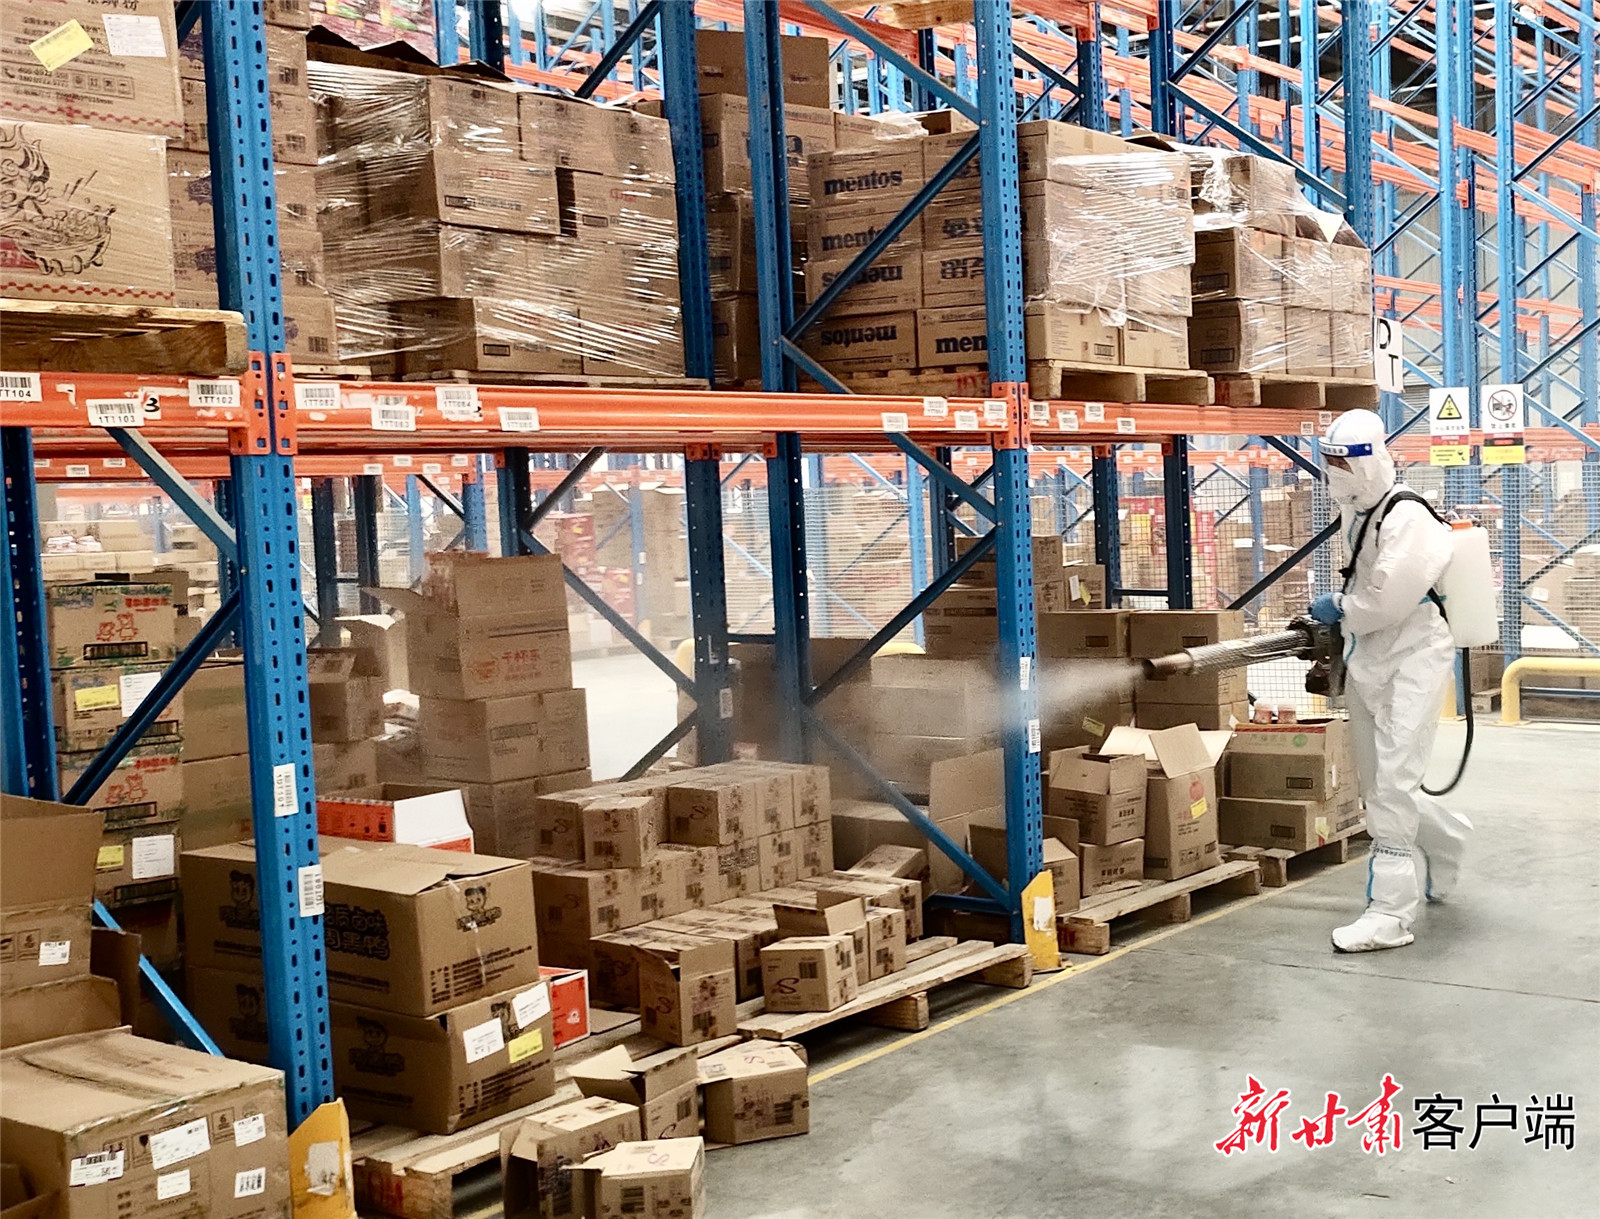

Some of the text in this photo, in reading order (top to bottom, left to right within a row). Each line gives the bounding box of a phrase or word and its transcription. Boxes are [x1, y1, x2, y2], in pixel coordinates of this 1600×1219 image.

[823, 170, 903, 196] mentos
[821, 325, 897, 347] mentos
[935, 334, 987, 354] men
[143, 397, 160, 413] 3
[198, 395, 233, 404] 1TT102
[98, 415, 136, 423] 1TT103
